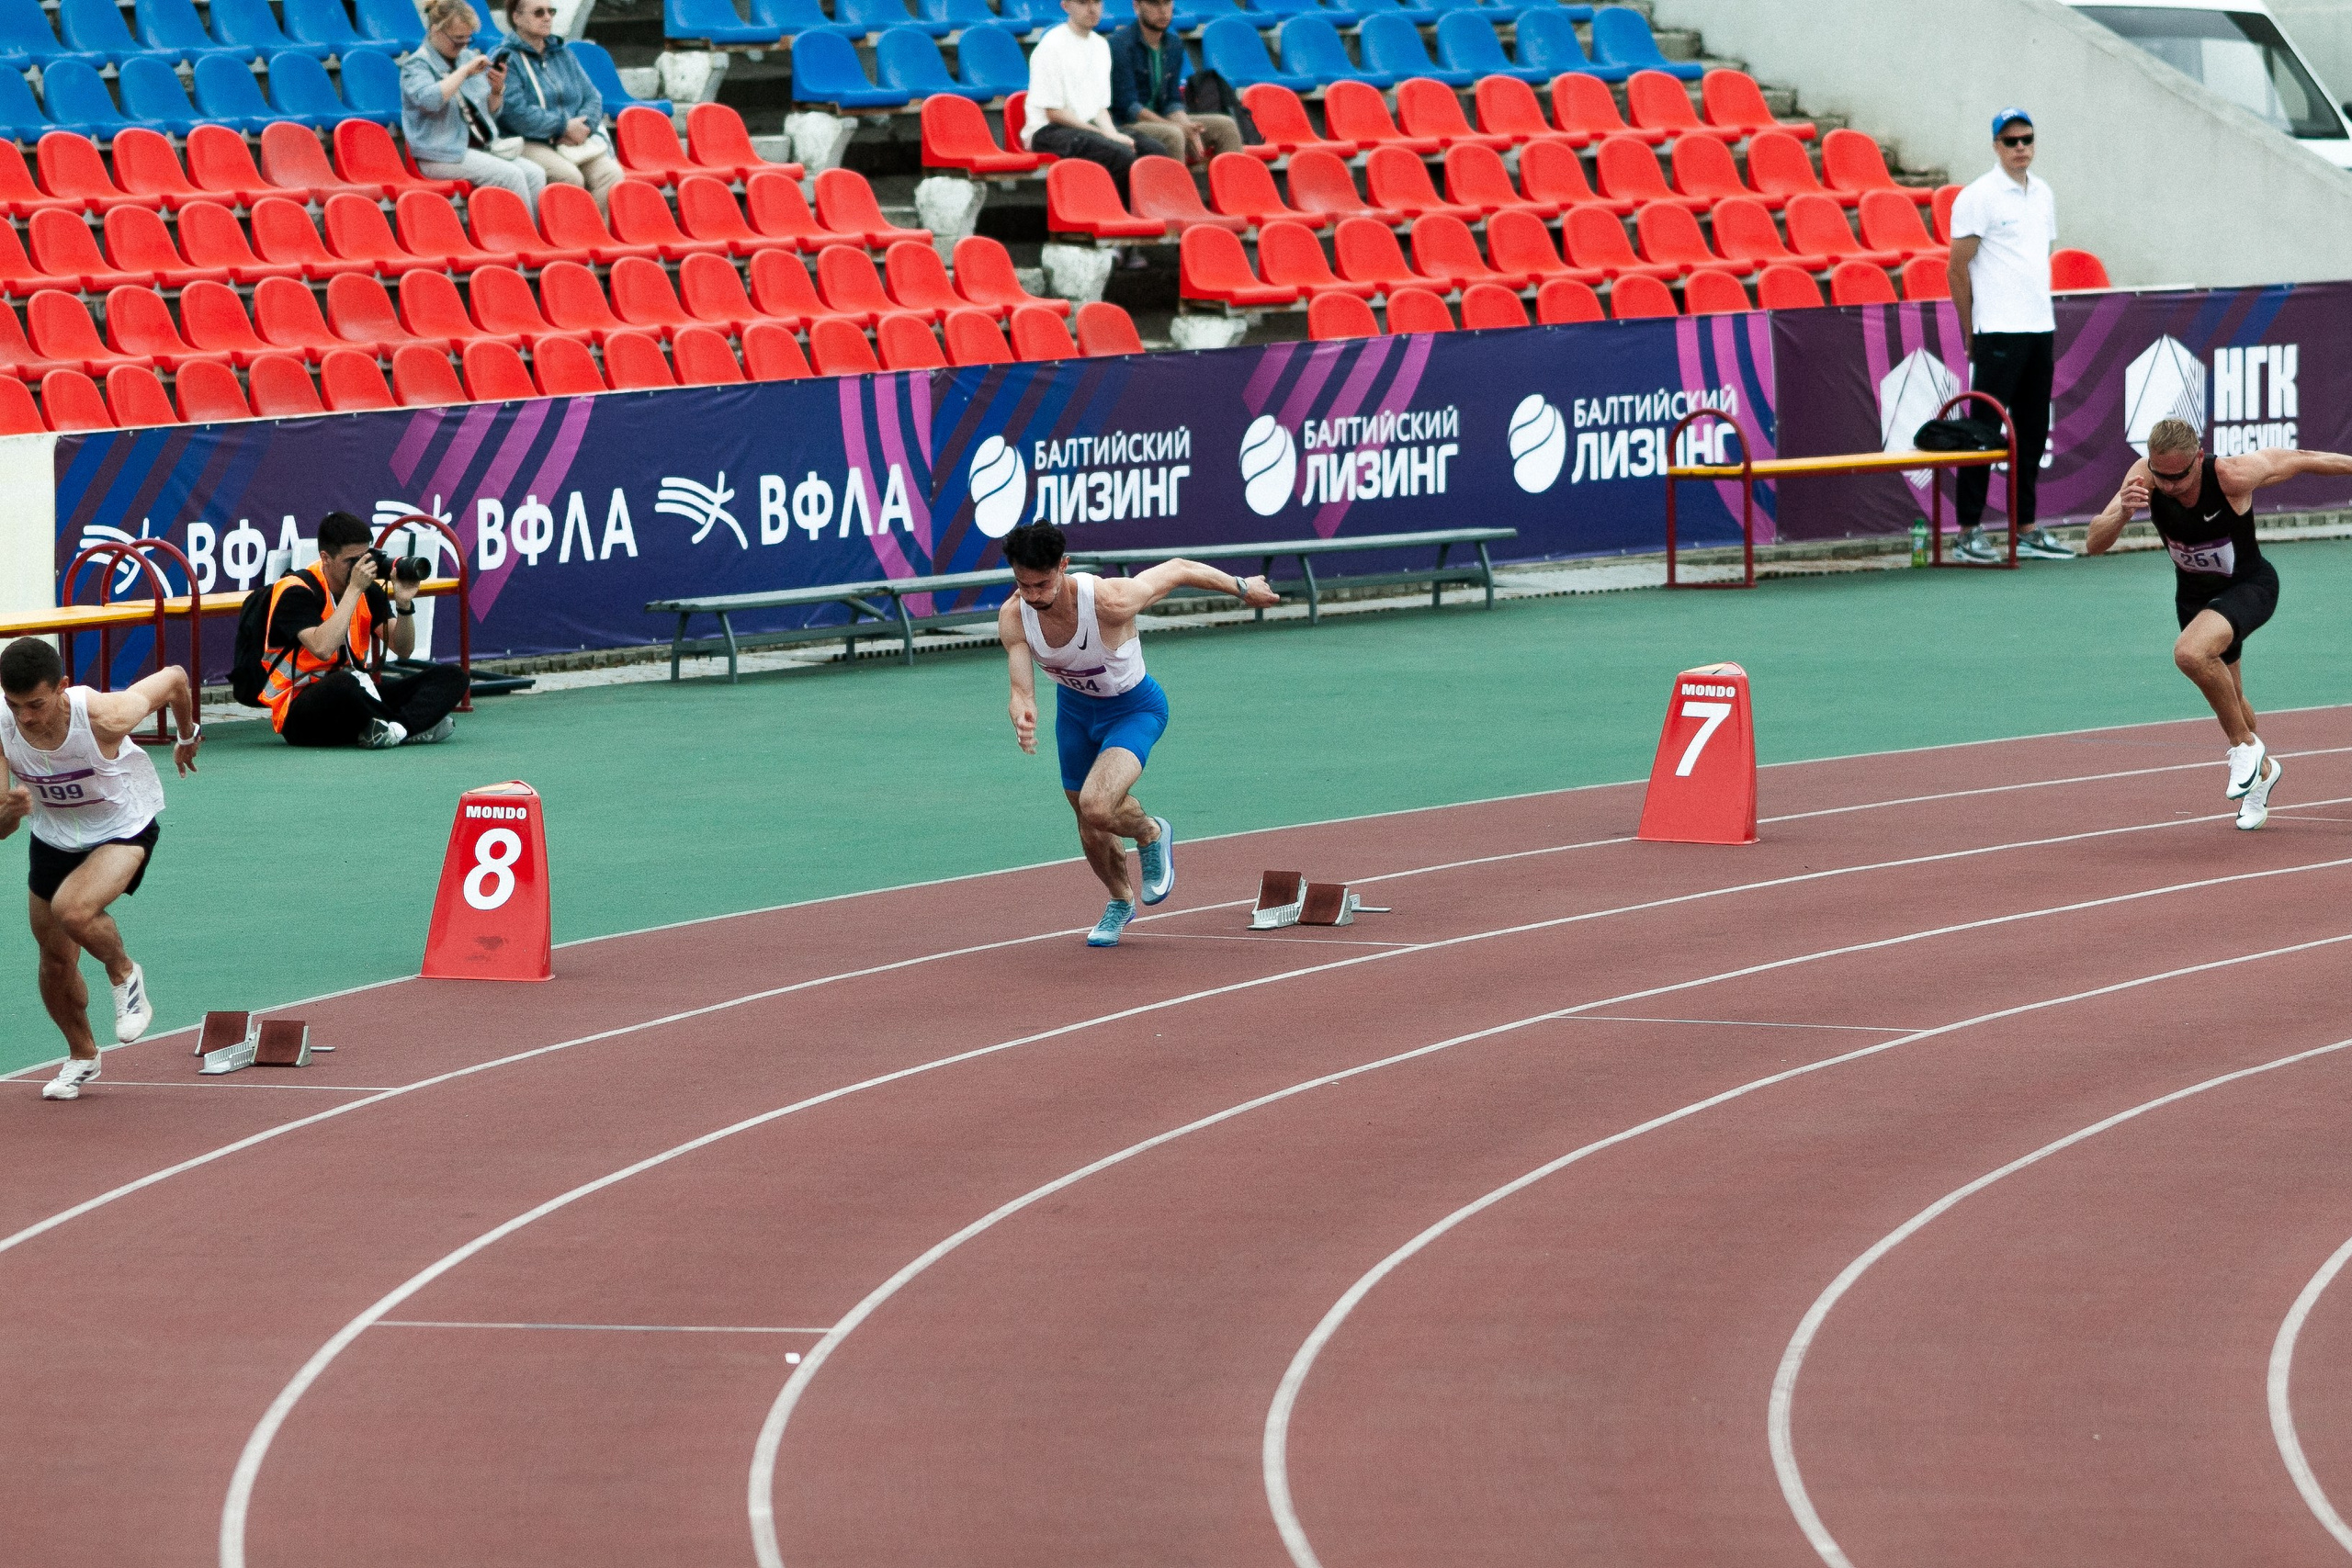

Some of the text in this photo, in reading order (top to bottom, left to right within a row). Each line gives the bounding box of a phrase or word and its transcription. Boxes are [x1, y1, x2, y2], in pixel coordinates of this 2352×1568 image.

[1573, 383, 1739, 428] БАЛТИЙСКИЙ
[2213, 344, 2298, 422] НГК
[1035, 425, 1191, 470] БАЛТИЙСКИЙ
[1304, 405, 1459, 449] БАЛТИЙСКИЙ
[760, 463, 915, 546] ВФЛА
[1032, 465, 1191, 525] ЛИЗИНГ
[1301, 443, 1459, 507] ЛИЗИНГ
[477, 487, 639, 570] ВФЛА
[1681, 683, 1736, 698] MONDO
[1675, 701, 1732, 777] 7
[35, 784, 85, 801] 199
[466, 805, 526, 820] MONDO
[463, 828, 522, 910] 8
